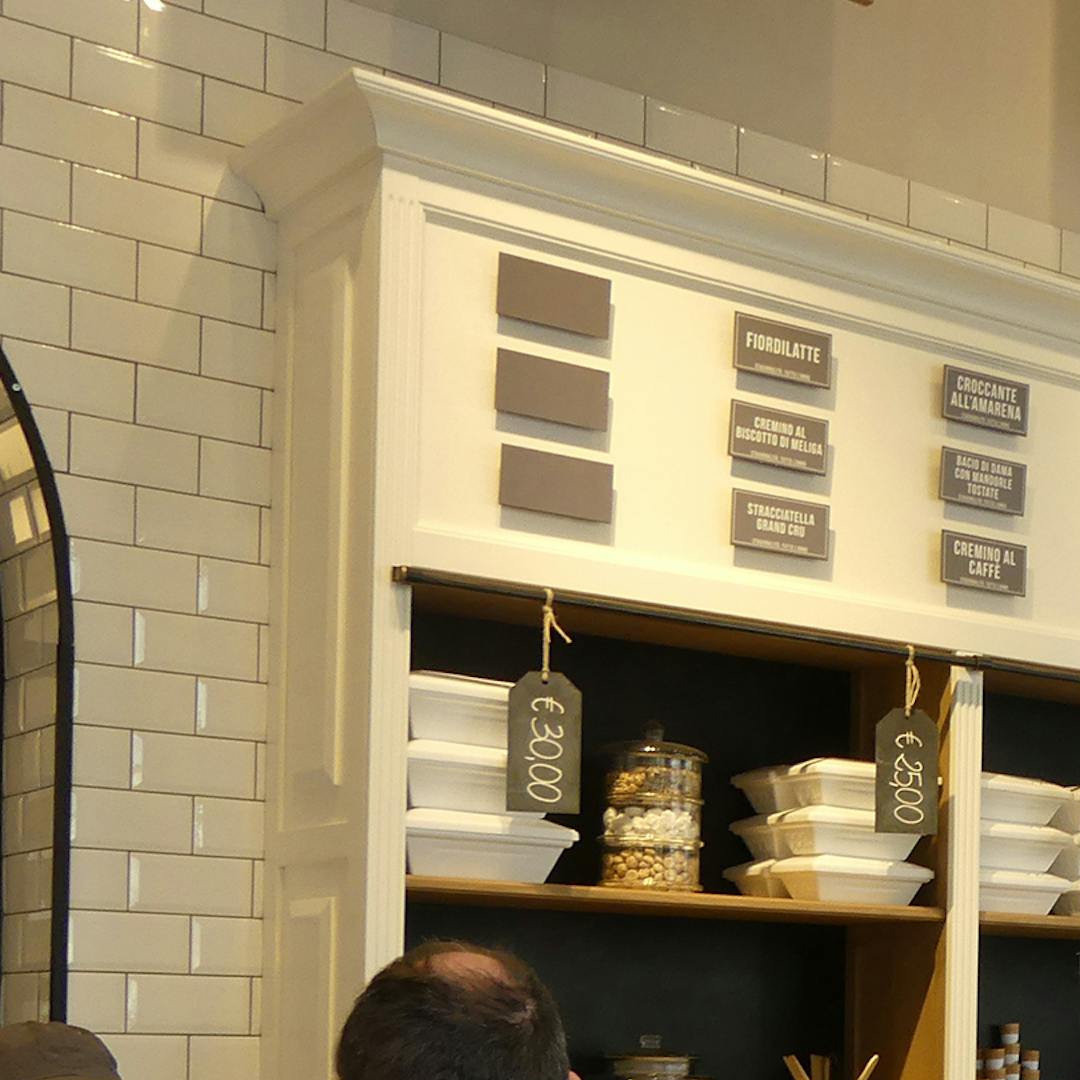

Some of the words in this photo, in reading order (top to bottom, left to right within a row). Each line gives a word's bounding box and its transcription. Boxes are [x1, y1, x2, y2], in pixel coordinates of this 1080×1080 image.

[746, 331, 821, 364] FIORDILATTE
[956, 374, 1018, 403] CROCCANTE
[950, 392, 1022, 423] ALL'AMARENA
[735, 425, 778, 446] BISCOTTO
[779, 436, 790, 449] DI
[791, 439, 823, 457] MELIGA
[754, 416, 794, 436] CREMINO
[795, 425, 807, 439] AL
[954, 467, 971, 481] CON
[967, 483, 1000, 500] TOSTATE
[746, 502, 816, 526] STRACCIATELLA
[756, 518, 786, 535] GRAND
[788, 522, 806, 538] CRU
[953, 540, 1001, 563] CREMINO
[1003, 550, 1017, 566] AL
[525, 716, 565, 804] 30,00
[892, 753, 925, 825] 25,00
